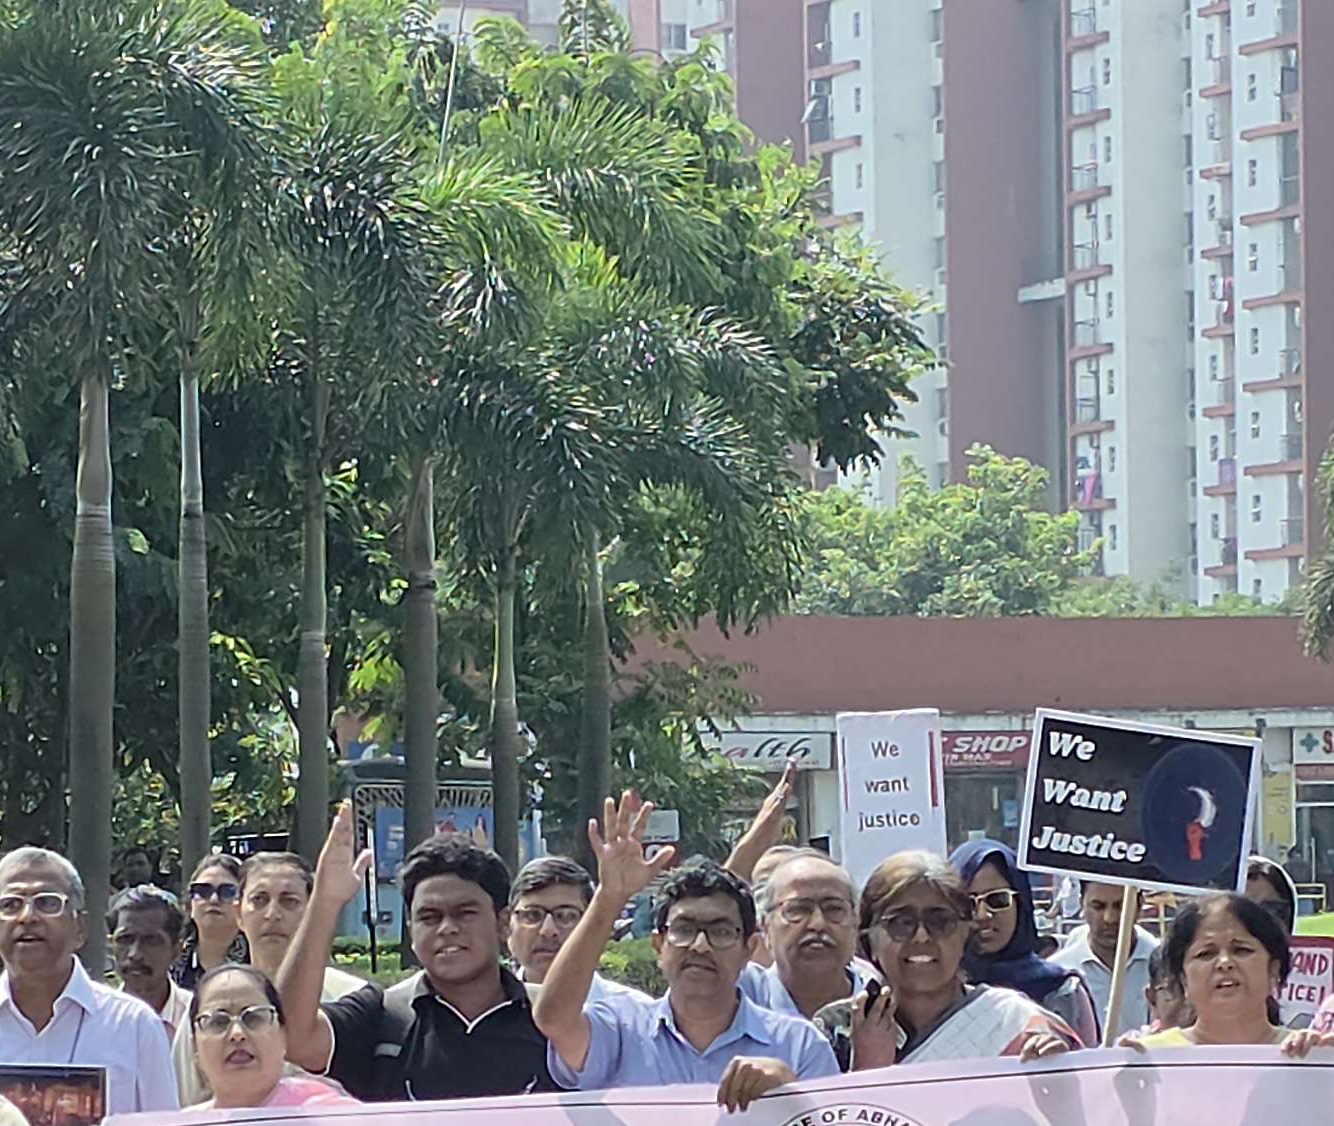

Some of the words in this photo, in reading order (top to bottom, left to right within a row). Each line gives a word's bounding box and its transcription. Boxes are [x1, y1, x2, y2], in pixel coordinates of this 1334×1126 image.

[870, 740, 900, 758] We
[952, 735, 1029, 753] SHOP
[1048, 730, 1096, 761] We
[864, 775, 910, 794] want
[1043, 777, 1128, 813] Want
[858, 810, 921, 833] justice
[1031, 825, 1147, 863] Justice
[1291, 951, 1329, 977] AND
[821, 1108, 849, 1124] OF
